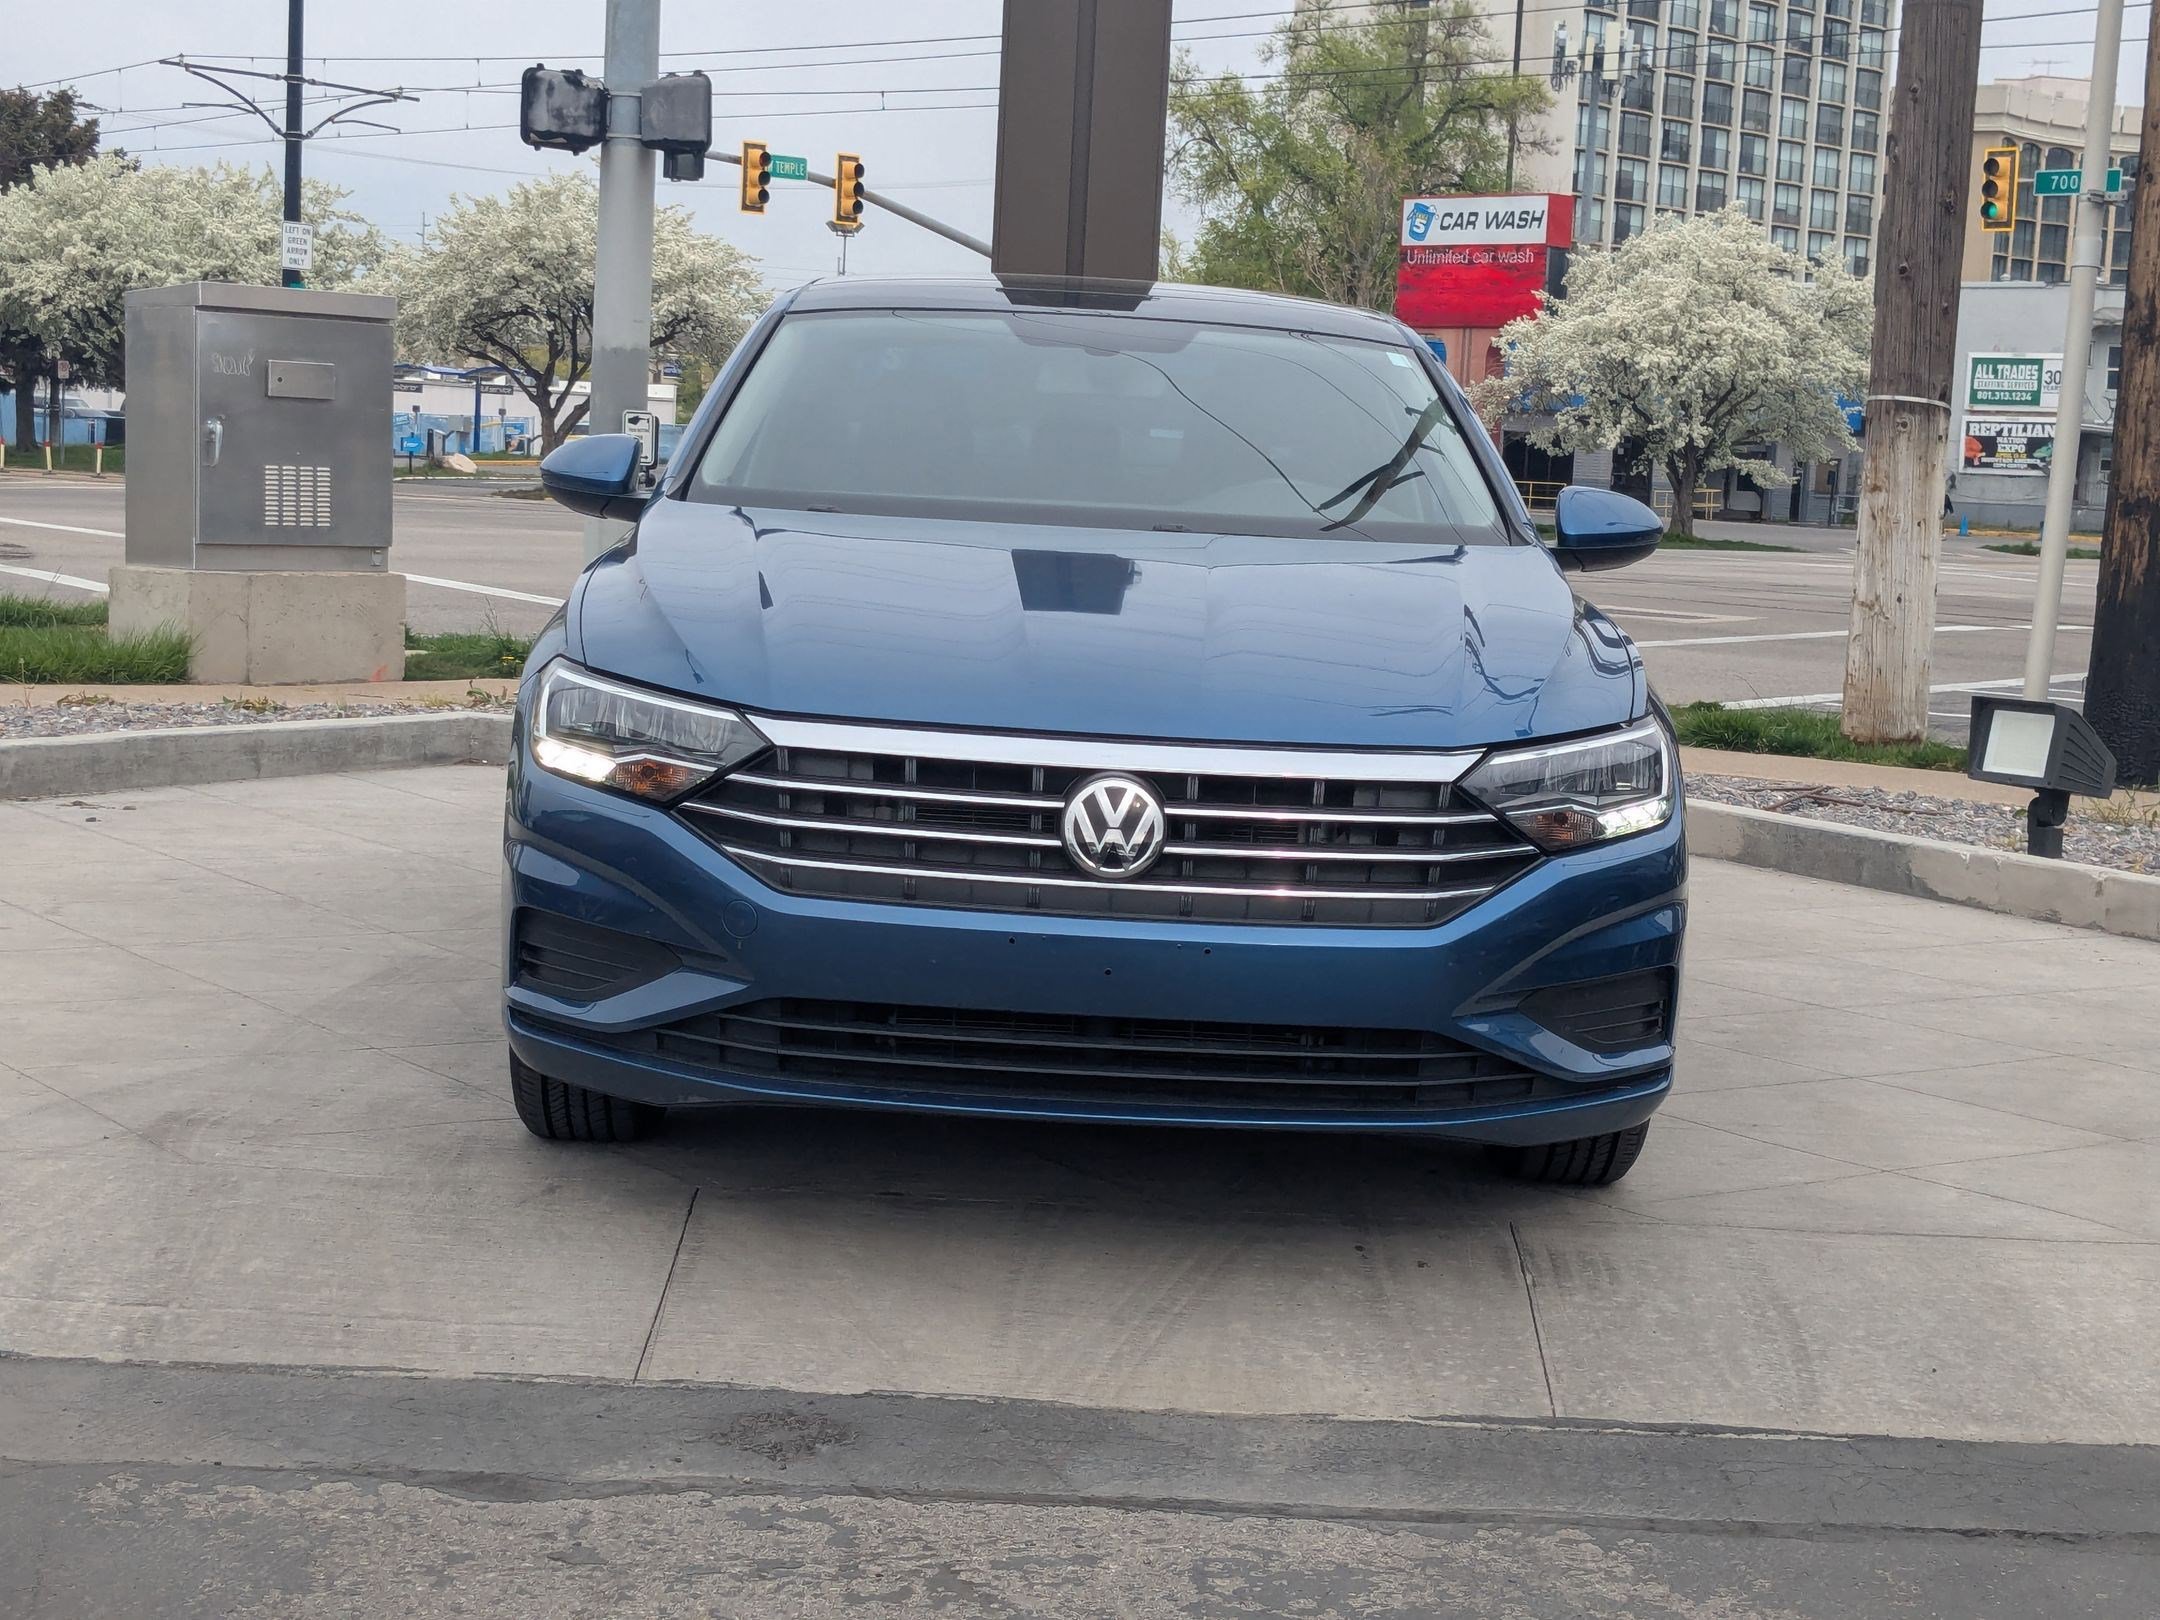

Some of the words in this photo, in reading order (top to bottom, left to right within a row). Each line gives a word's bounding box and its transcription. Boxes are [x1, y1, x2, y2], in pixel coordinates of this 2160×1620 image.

[776, 161, 805, 176] TEMPLE
[2051, 175, 2078, 190] 700
[1412, 219, 1428, 234] 5
[1439, 212, 1479, 231] CAR
[1485, 209, 1545, 230] WASH
[284, 225, 300, 234] LEFT
[302, 228, 311, 236] ON
[287, 236, 308, 246] GREEN
[286, 246, 308, 256] ARROW
[1406, 248, 1469, 265] Unlimited
[1472, 252, 1493, 264] car
[1498, 248, 1534, 264] wash
[288, 257, 305, 266] ONLY
[1974, 364, 1995, 379] ALL
[1996, 364, 2039, 380] TRADES
[2044, 370, 2062, 385] 30
[1976, 391, 2032, 400] 801.313.1234
[1969, 423, 2056, 437] REPTILIAN
[1996, 436, 2028, 444] NATION
[1997, 444, 2026, 453] EXPO
